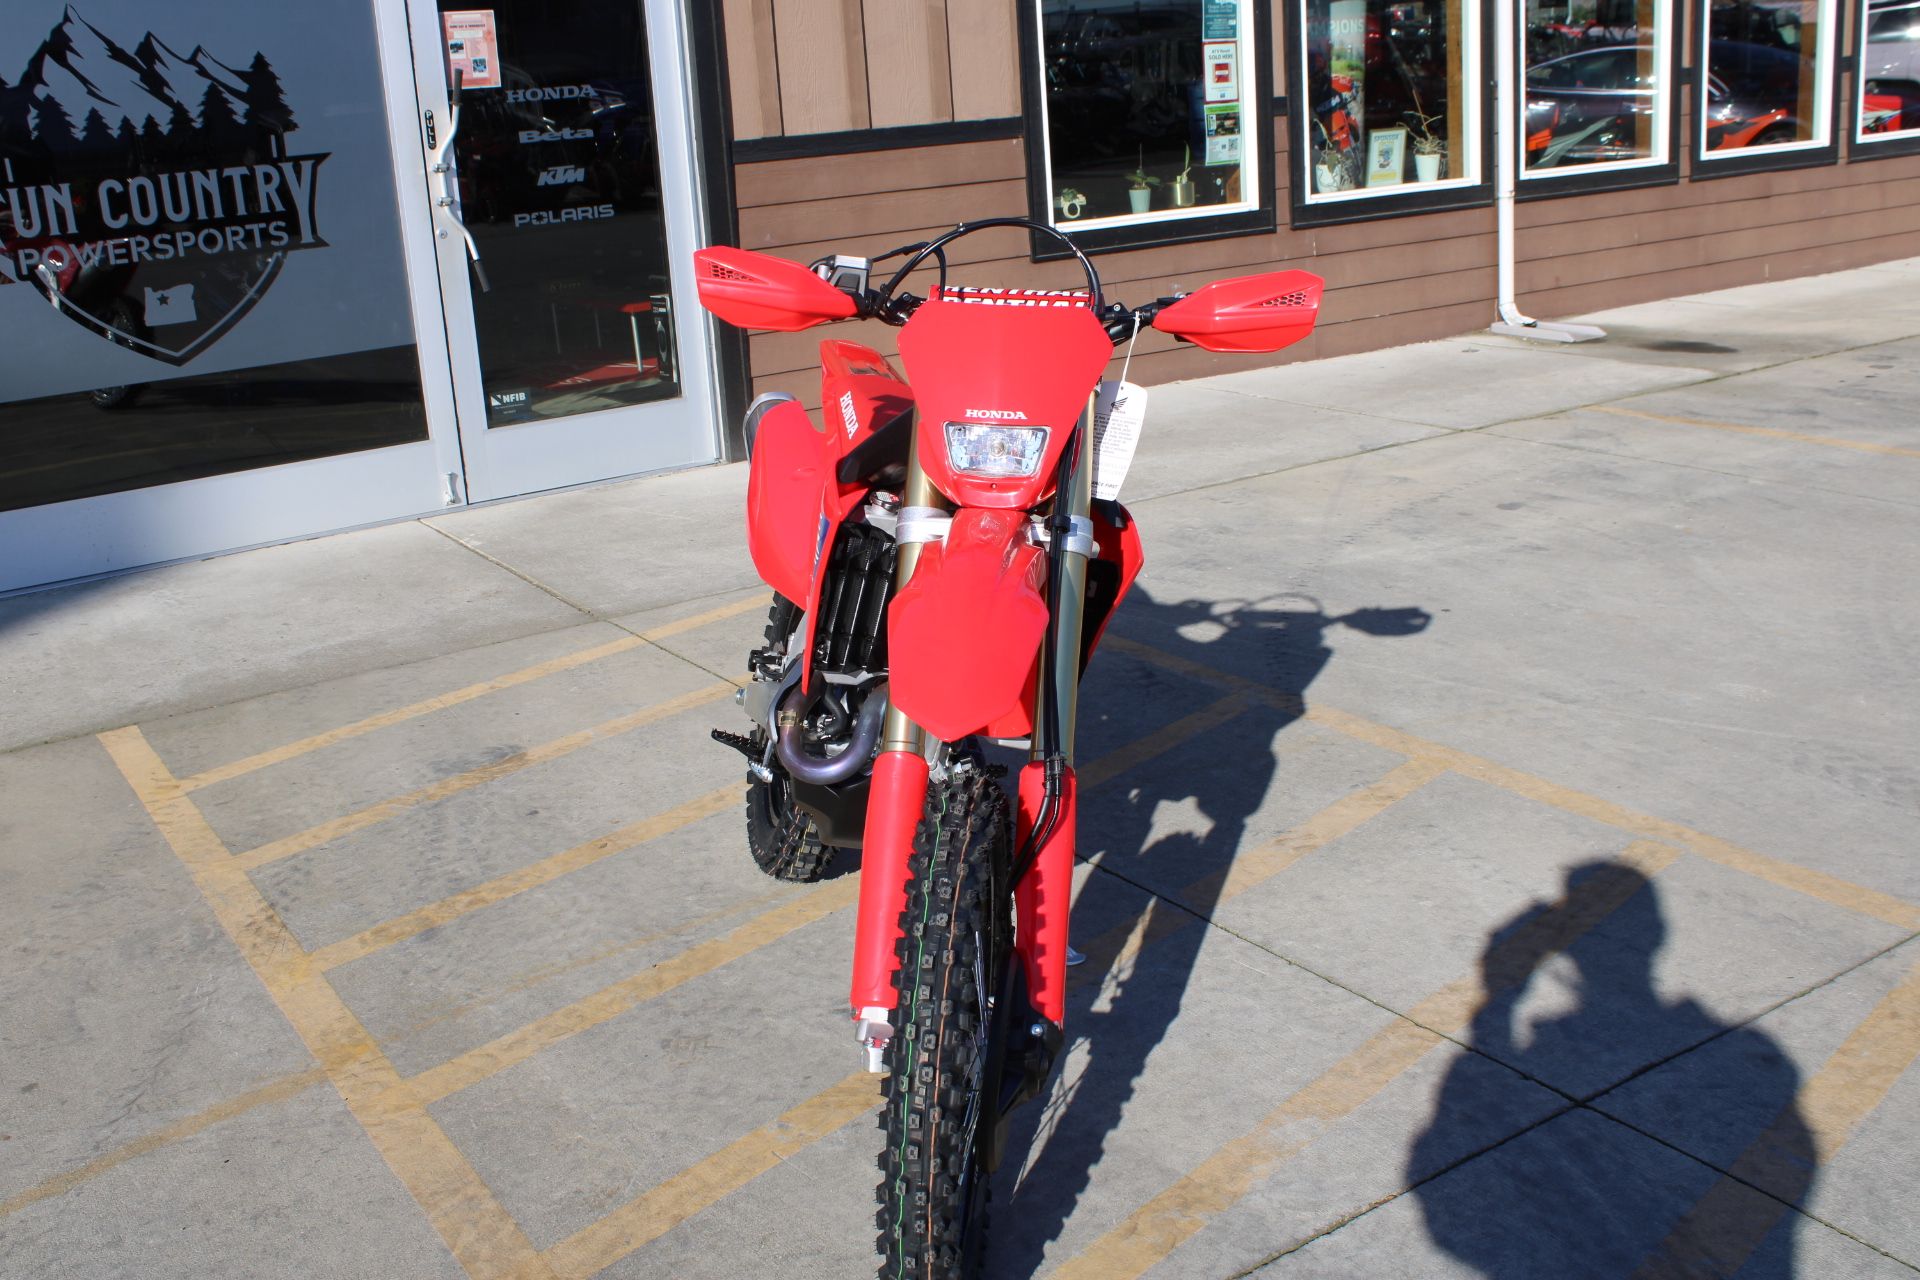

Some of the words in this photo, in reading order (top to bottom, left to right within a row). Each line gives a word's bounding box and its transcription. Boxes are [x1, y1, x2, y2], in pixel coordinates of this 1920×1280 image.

[505, 84, 598, 103] HONDA
[425, 111, 436, 144] PULL
[518, 127, 594, 144] Beta
[537, 164, 585, 186] KTM
[0, 183, 79, 238] UN
[98, 160, 317, 243] COUNTRY
[514, 204, 615, 227] POLARIS
[18, 221, 289, 276] POWERSPORTS
[502, 392, 526, 404] NFIB
[840, 391, 859, 440] HONDA
[965, 409, 1028, 420] HONDA
